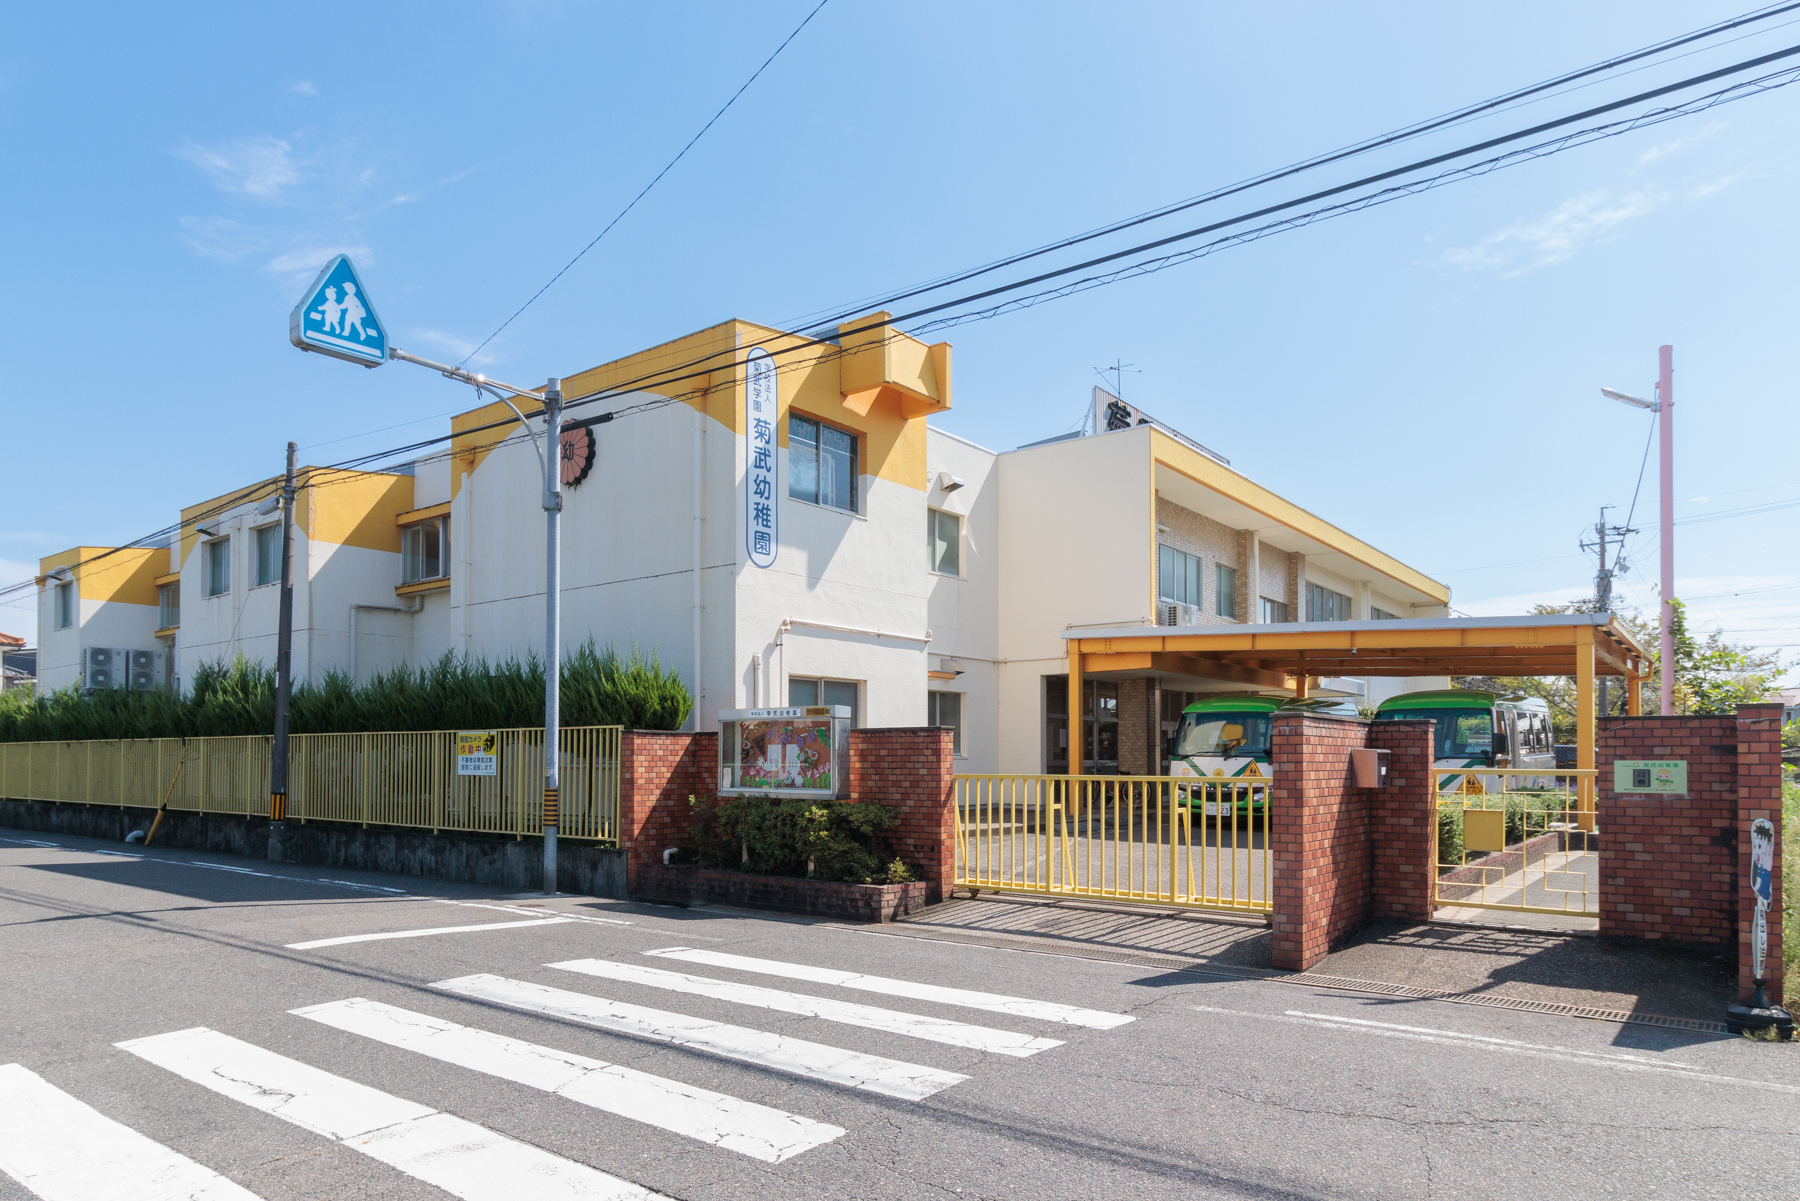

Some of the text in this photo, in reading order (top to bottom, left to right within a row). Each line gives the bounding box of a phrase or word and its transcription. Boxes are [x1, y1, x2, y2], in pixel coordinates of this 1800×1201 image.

[562, 440, 575, 461] 幼
[753, 417, 772, 556] 菊武幼稚園
[766, 709, 798, 717] 菊武幼稚園
[460, 735, 482, 743] 防犯カメラ
[460, 744, 482, 755] 作動中
